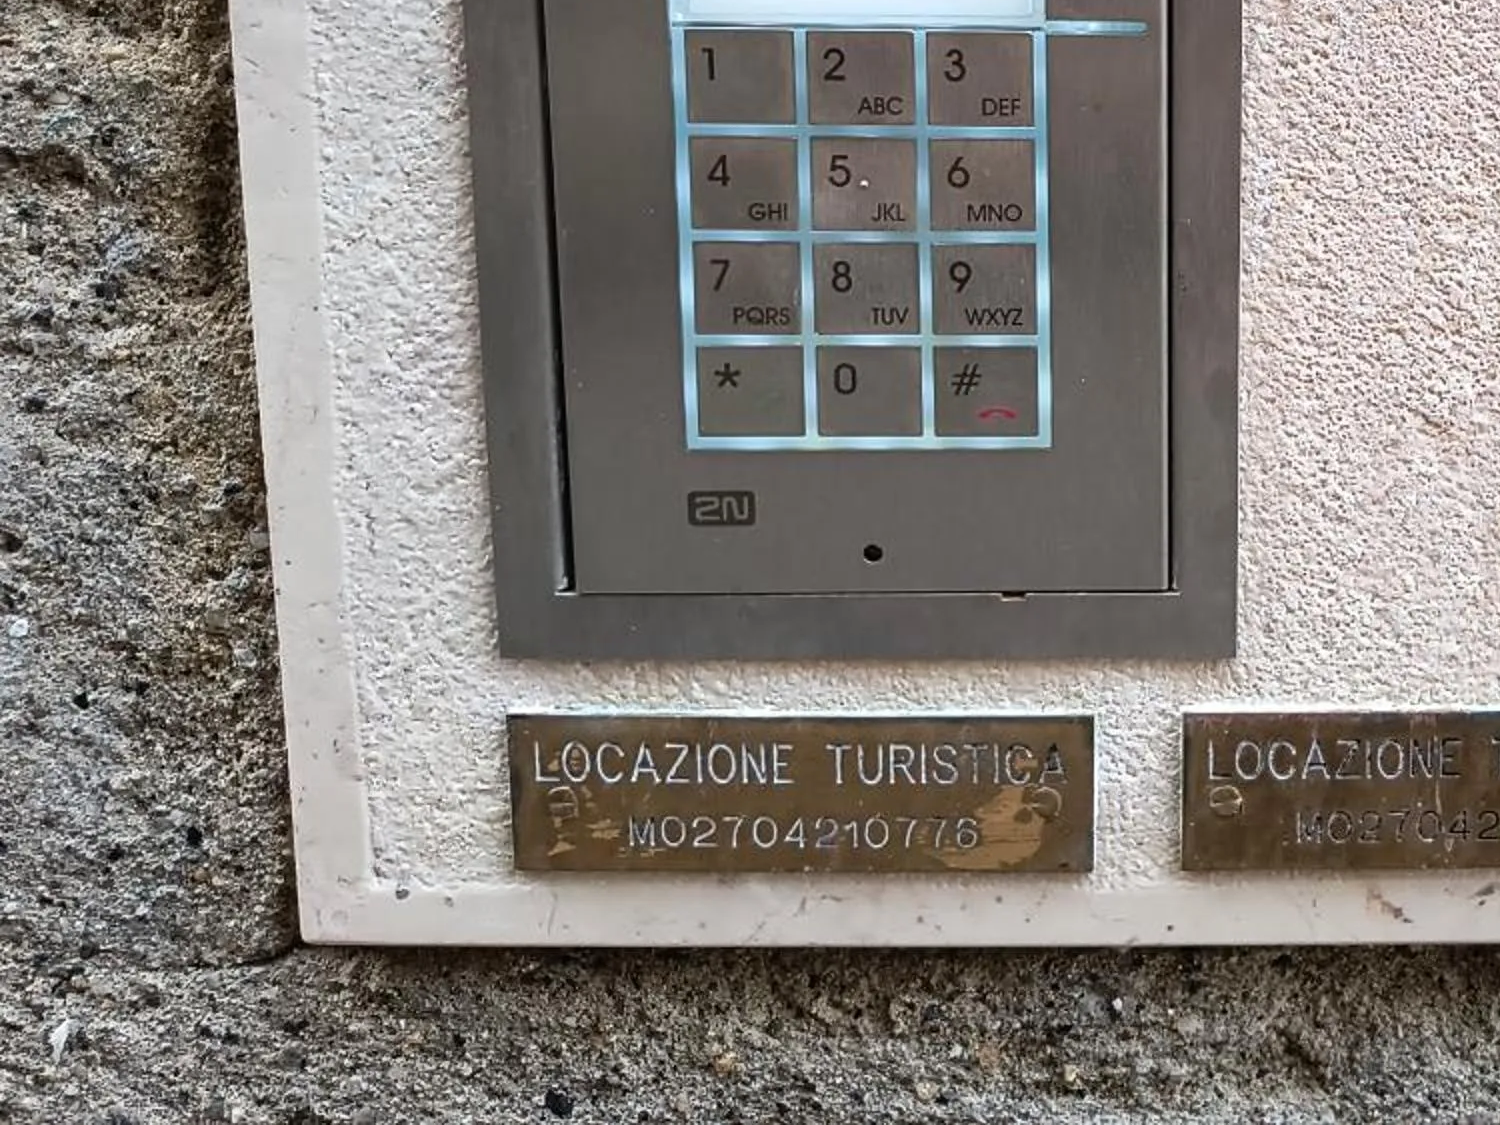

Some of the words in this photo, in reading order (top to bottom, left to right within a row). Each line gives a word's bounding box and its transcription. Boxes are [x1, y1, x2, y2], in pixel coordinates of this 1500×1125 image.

[701, 48, 716, 81] 1
[823, 49, 846, 82] 2
[944, 49, 966, 83] 3
[858, 97, 903, 116] ABC
[982, 98, 1021, 117] DEF
[707, 155, 730, 187] 4
[829, 155, 851, 188] 5
[948, 156, 971, 189] 6
[748, 203, 788, 222] GHI
[872, 203, 906, 223] JKL
[967, 204, 1023, 223] MNO
[710, 259, 731, 293] 7
[831, 261, 852, 293] 8
[949, 261, 972, 293] 9
[733, 308, 791, 327] PQRS
[872, 308, 909, 327] TUV
[965, 308, 1023, 327] WXYZ
[834, 363, 857, 395] 0
[534, 741, 794, 784] LOCAZIONE
[827, 743, 1068, 786] TURISTICA
[1207, 738, 1462, 781] LOCAZIONE
